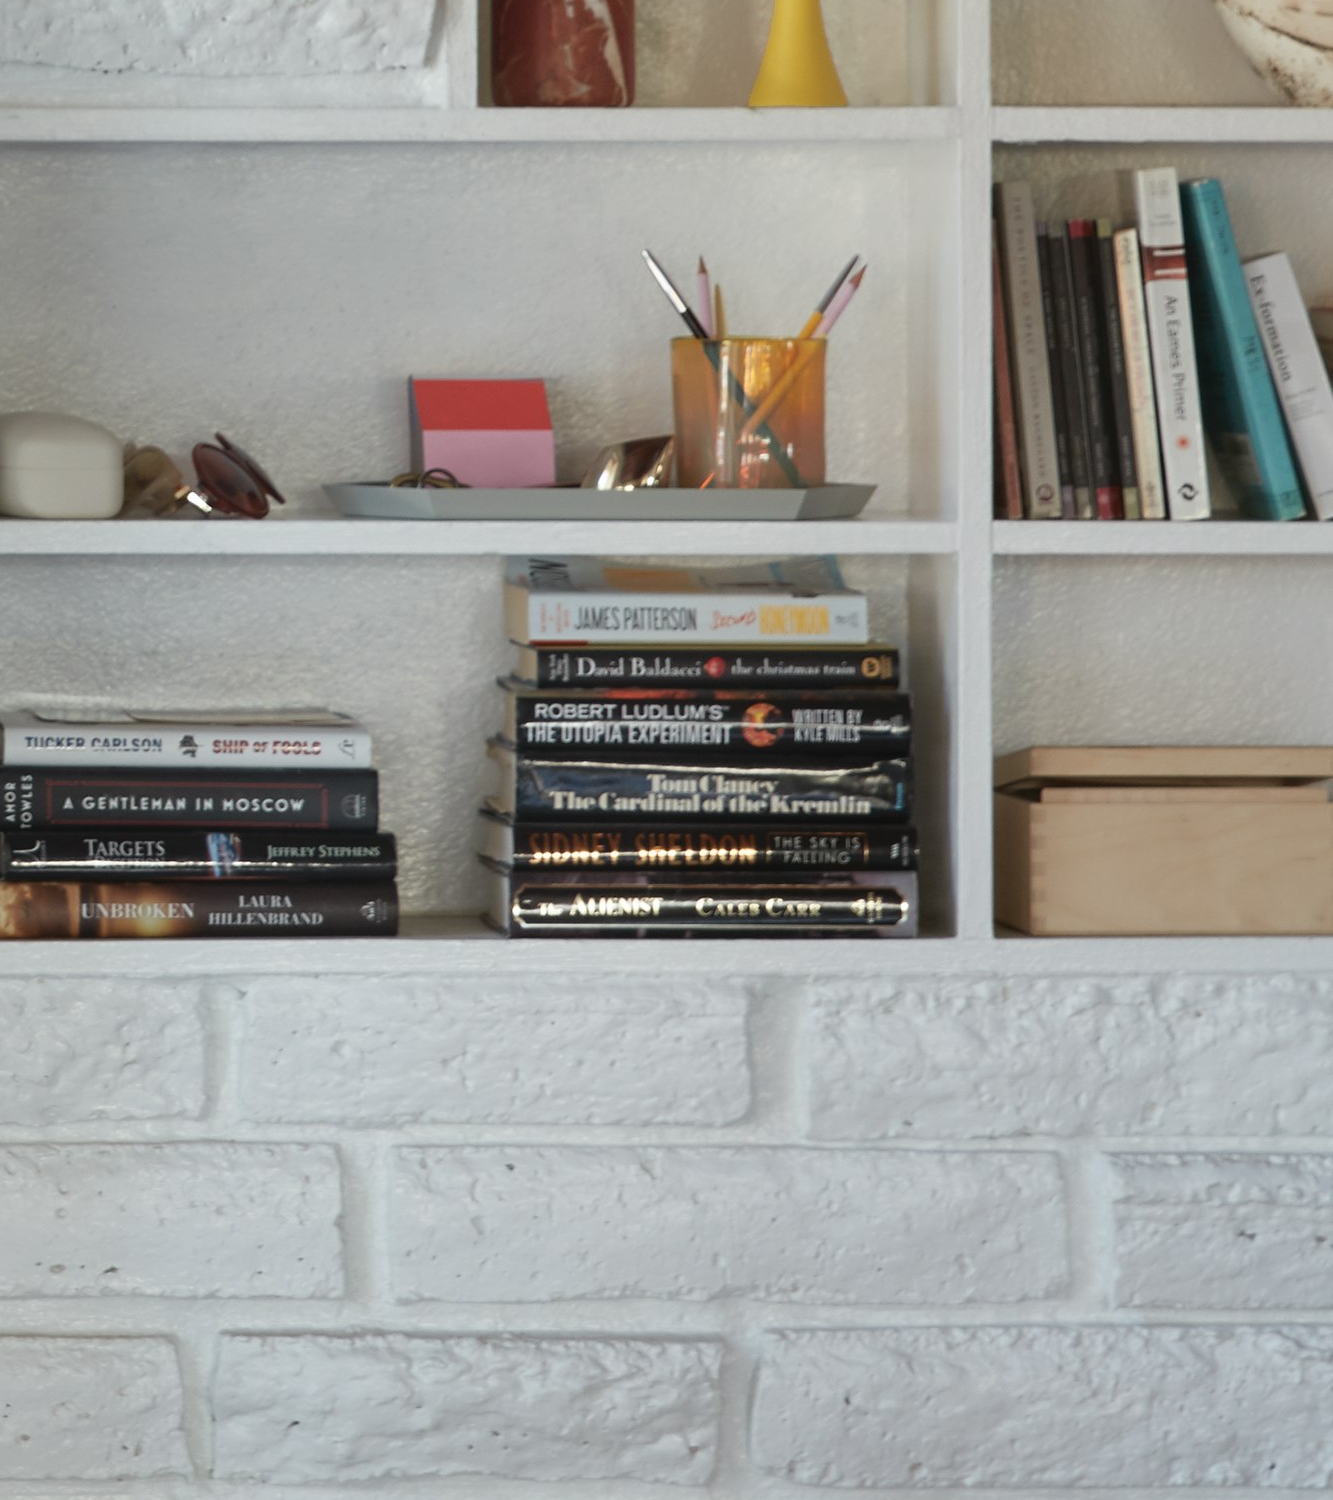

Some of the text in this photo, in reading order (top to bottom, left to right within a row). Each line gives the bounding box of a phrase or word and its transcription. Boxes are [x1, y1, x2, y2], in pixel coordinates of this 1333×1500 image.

[1165, 295, 1187, 421] An Eames Primer
[575, 606, 620, 631] JAMES
[623, 606, 697, 631] PATTERSON
[576, 656, 625, 677] David
[630, 656, 701, 677] Baldacci
[731, 657, 856, 676] the christmas train
[534, 703, 617, 720] ROBERT
[791, 708, 843, 725] WRITTEN
[845, 708, 863, 725] BY
[525, 722, 732, 745] THE UTOPIA EXPERIMENT
[793, 725, 823, 743] KYLE
[24, 736, 163, 753] TUCKER CARLSON
[212, 739, 249, 754] SHIP
[272, 740, 323, 756] FOOLS
[646, 773, 780, 795] Tom Clancy
[4, 782, 16, 823] AMOR
[20, 774, 33, 829] TOWLES
[62, 796, 305, 812] A GENTLEMAN IN MOSCOW
[548, 790, 597, 811] The
[598, 791, 701, 813] Cardinal
[702, 794, 727, 813] of
[728, 793, 768, 814] the
[769, 794, 872, 814] Kremlin
[83, 838, 166, 857] TARGETS
[529, 832, 758, 866] SIDNEY SHELDON
[773, 835, 862, 850] THE SKY IS
[266, 844, 381, 860] JEFFREY STEPHENS
[783, 850, 853, 864] FALLING
[238, 894, 294, 908] LAURA
[694, 896, 822, 917] CALEB CARR
[80, 902, 196, 920] UNBROKEN
[208, 912, 325, 926] HILLENBRAND
